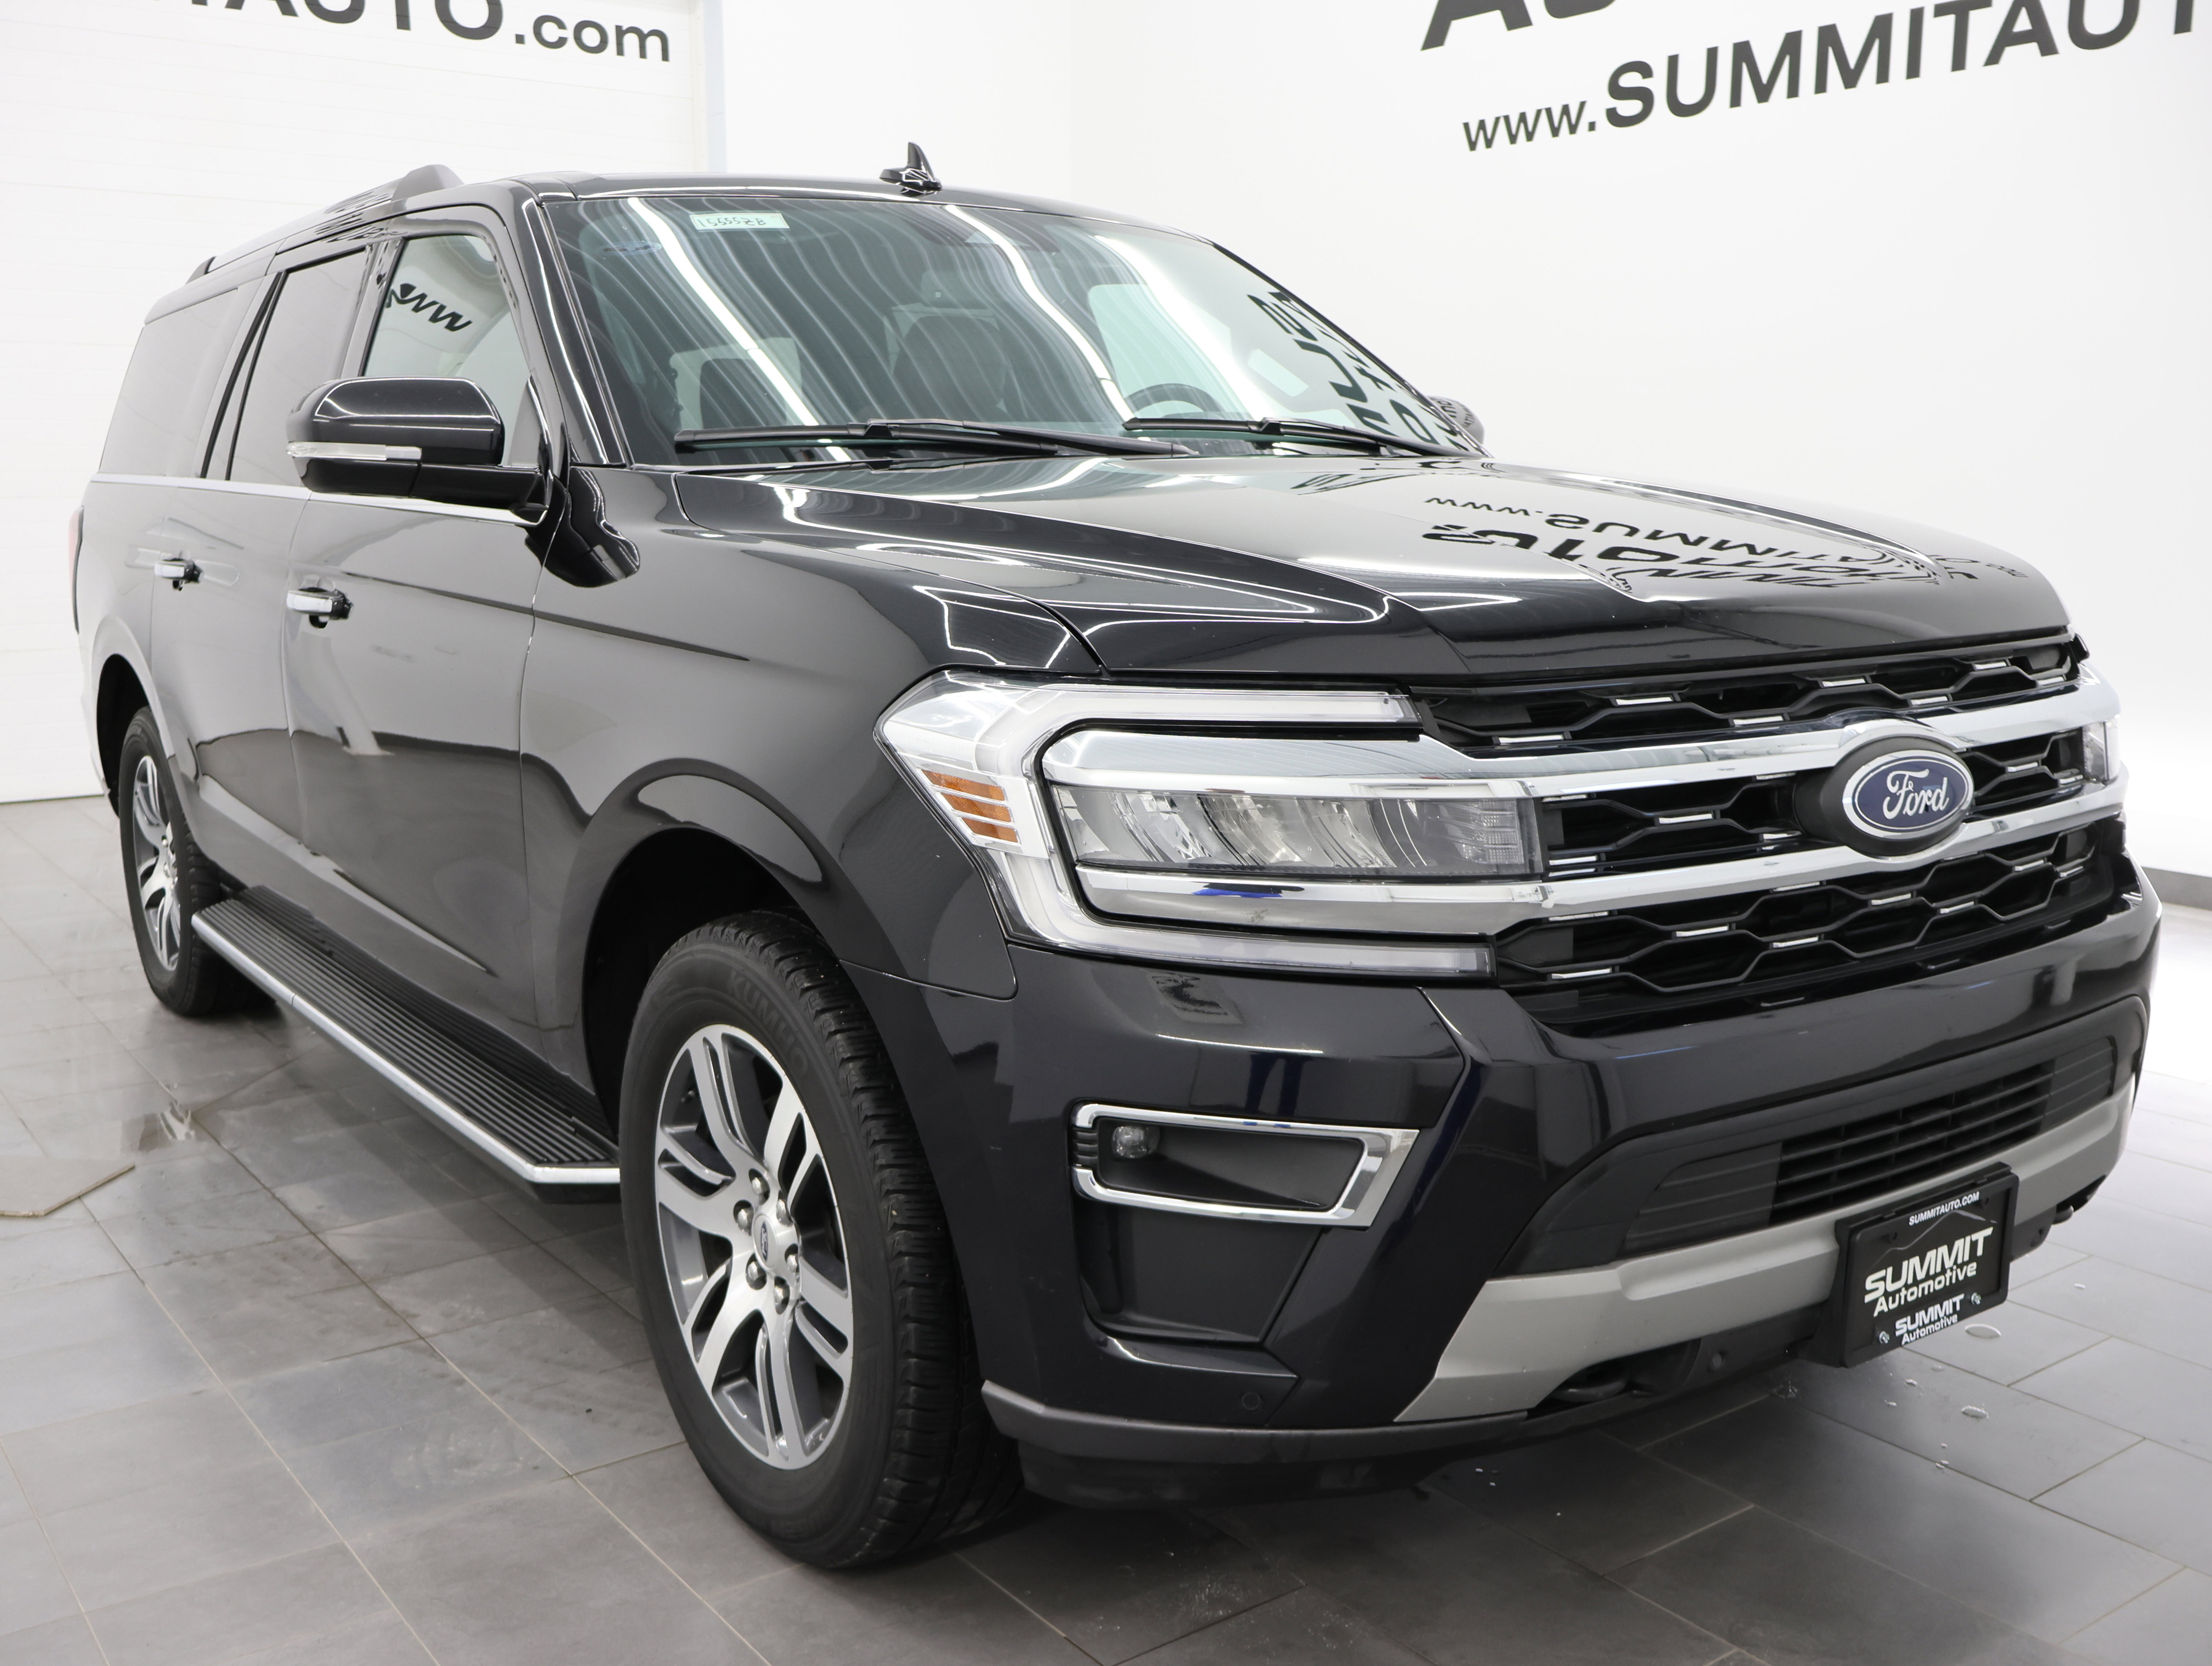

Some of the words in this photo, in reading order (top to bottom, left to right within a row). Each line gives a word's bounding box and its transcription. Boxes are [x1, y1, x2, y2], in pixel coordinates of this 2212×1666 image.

[1883, 769, 1950, 820] Ford
[1909, 1191, 1980, 1226] SUMMITAUTO.COM
[1864, 1226, 1994, 1303] SUMMIT
[1873, 1261, 1977, 1318] Automotive
[1895, 1293, 1965, 1337] SUMMIT
[1901, 1313, 1958, 1345] Automotive
